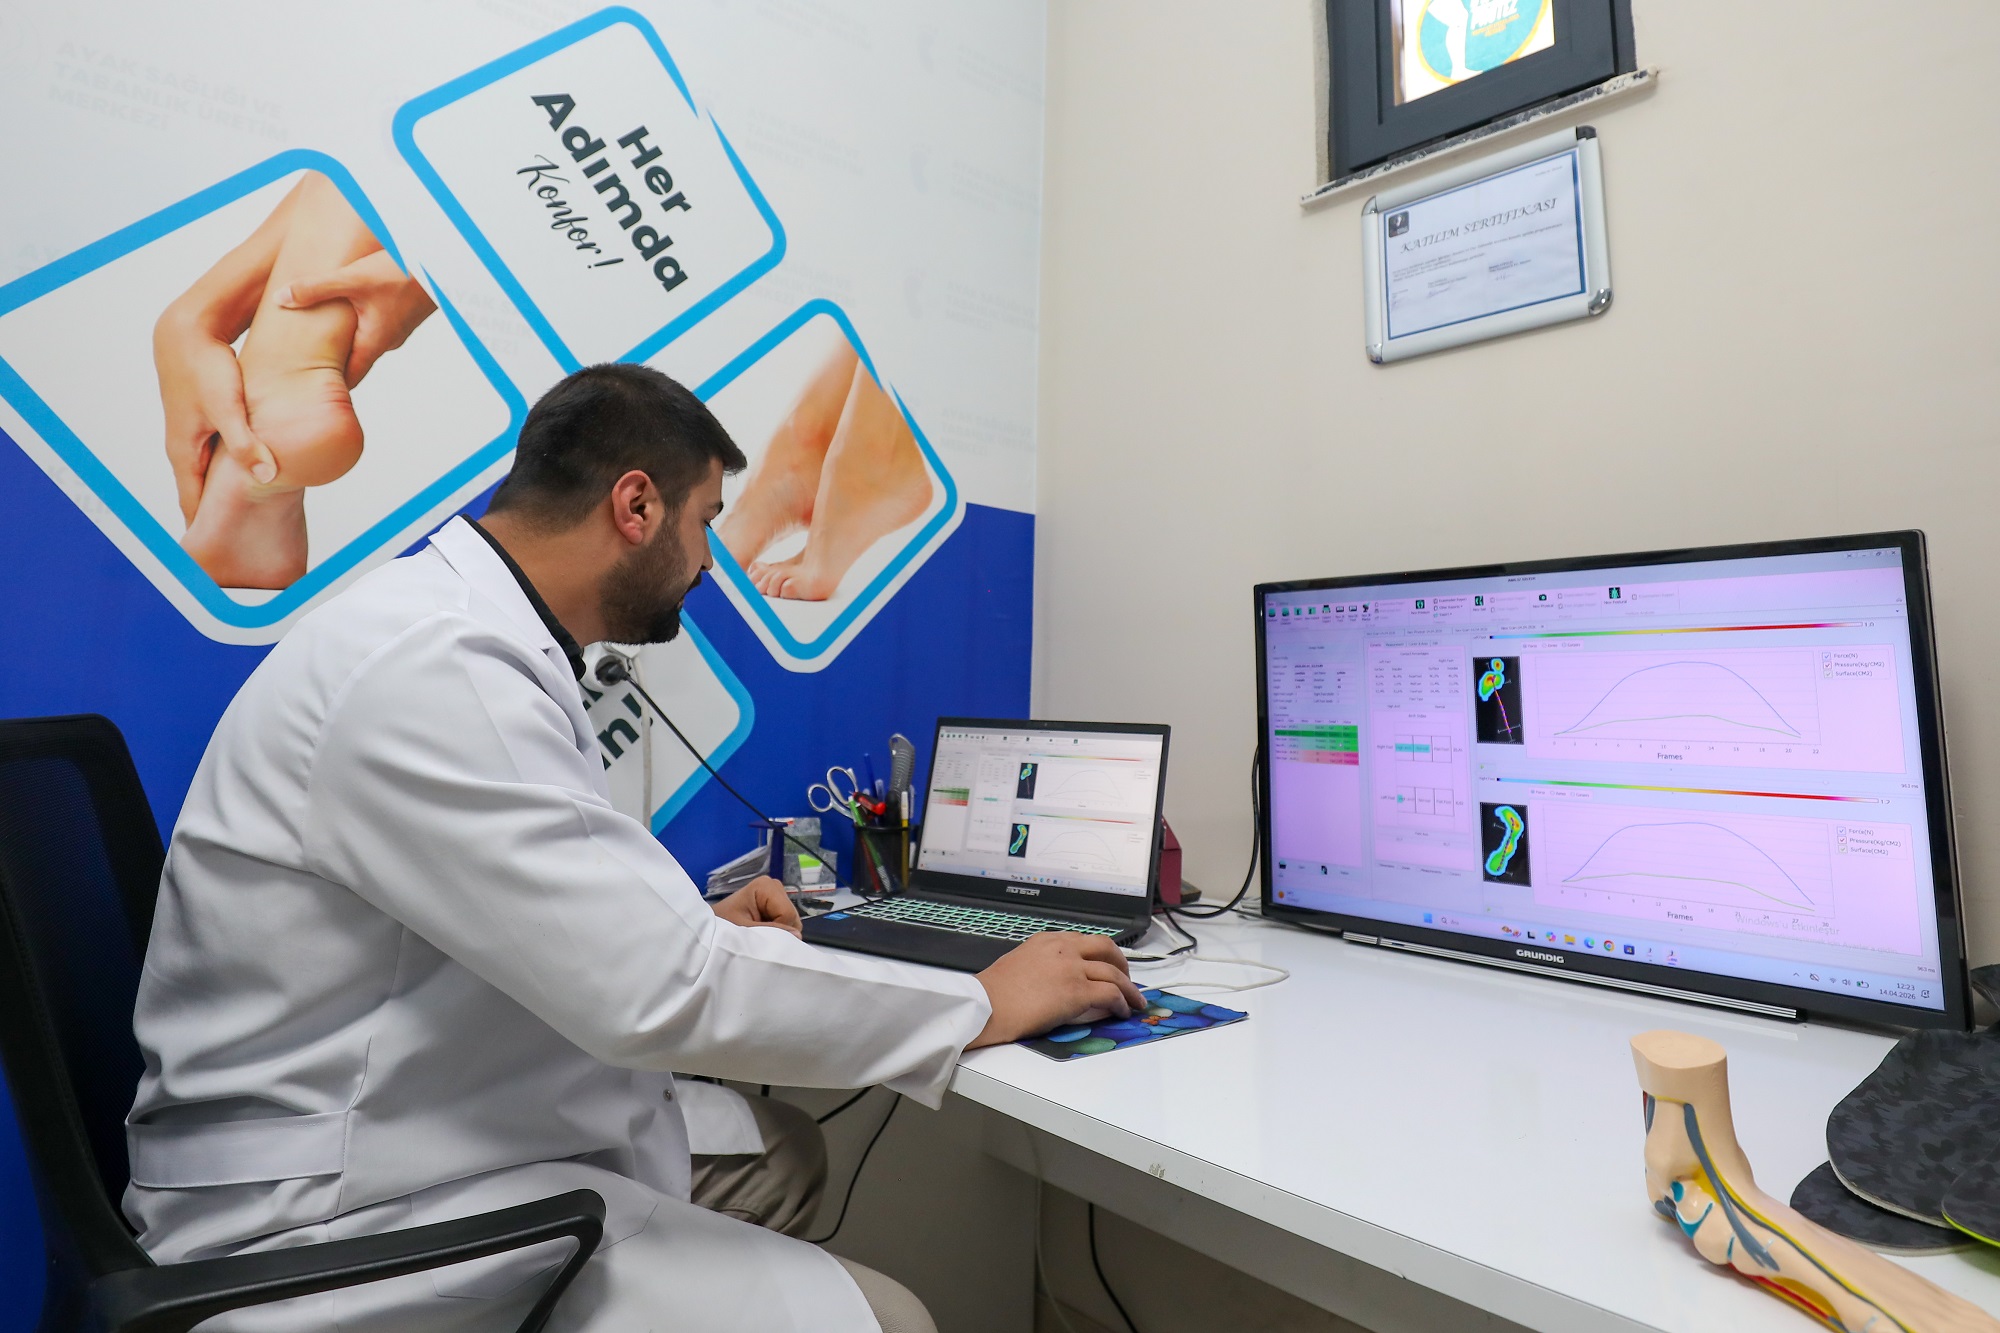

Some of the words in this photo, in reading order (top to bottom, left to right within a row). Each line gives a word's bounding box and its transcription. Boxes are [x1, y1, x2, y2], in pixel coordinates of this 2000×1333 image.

[57, 40, 139, 77] AYAK
[53, 61, 191, 115] TABANLIK
[617, 125, 692, 212] Her
[530, 93, 688, 293] Adımda
[516, 154, 624, 269] Konfor!
[1401, 227, 1460, 253] KATILIM
[1657, 753, 1683, 761] Frames
[1667, 911, 1694, 922] Frames
[1515, 948, 1565, 964] GRUNDIG
[1879, 988, 1916, 1000] 14.04.2026
[1896, 982, 1915, 991] 12:23
